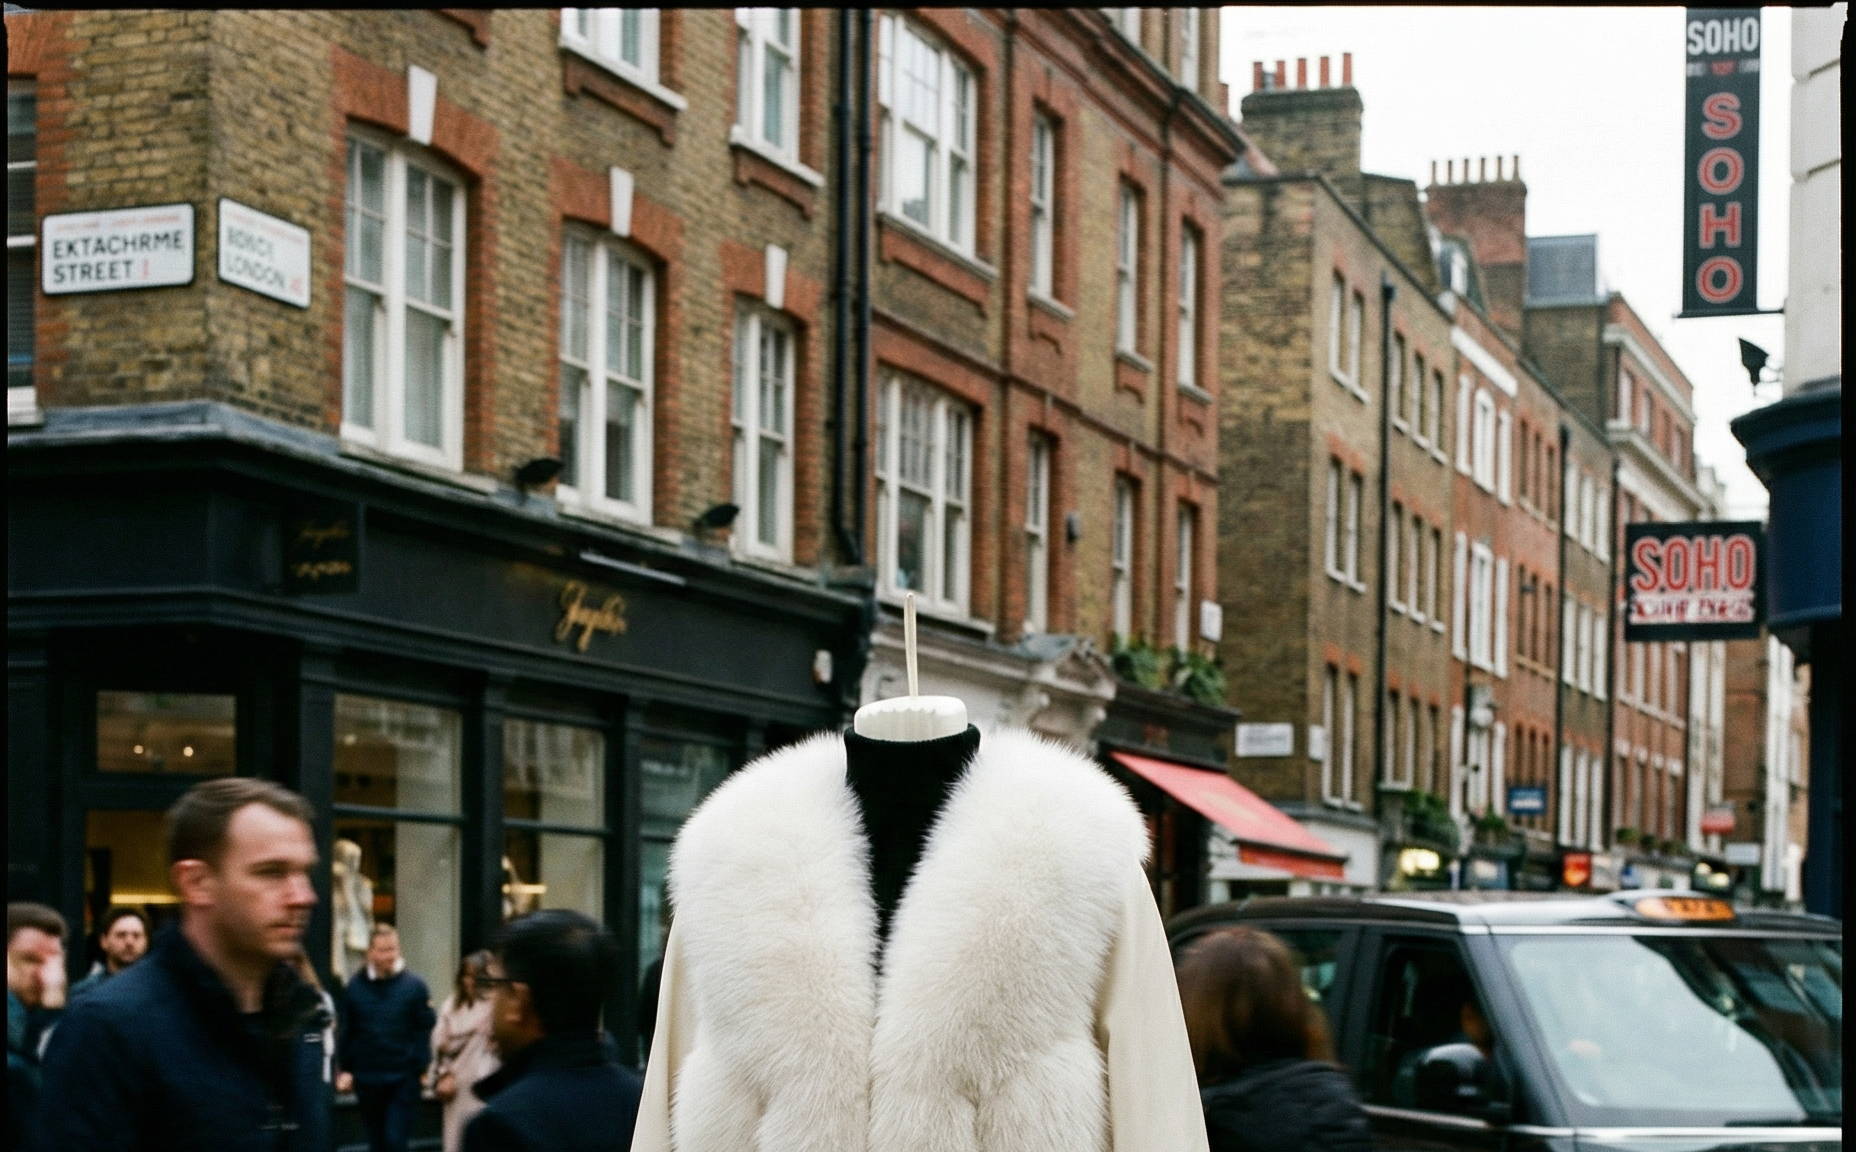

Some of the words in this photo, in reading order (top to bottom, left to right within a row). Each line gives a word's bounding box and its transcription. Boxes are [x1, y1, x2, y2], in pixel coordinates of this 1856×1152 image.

[1687, 17, 1759, 55] SOHO
[1696, 92, 1745, 303] SOHO
[53, 229, 184, 260] EKTACHRME
[53, 259, 133, 284] STREET
[1630, 533, 1756, 592] SOHO
